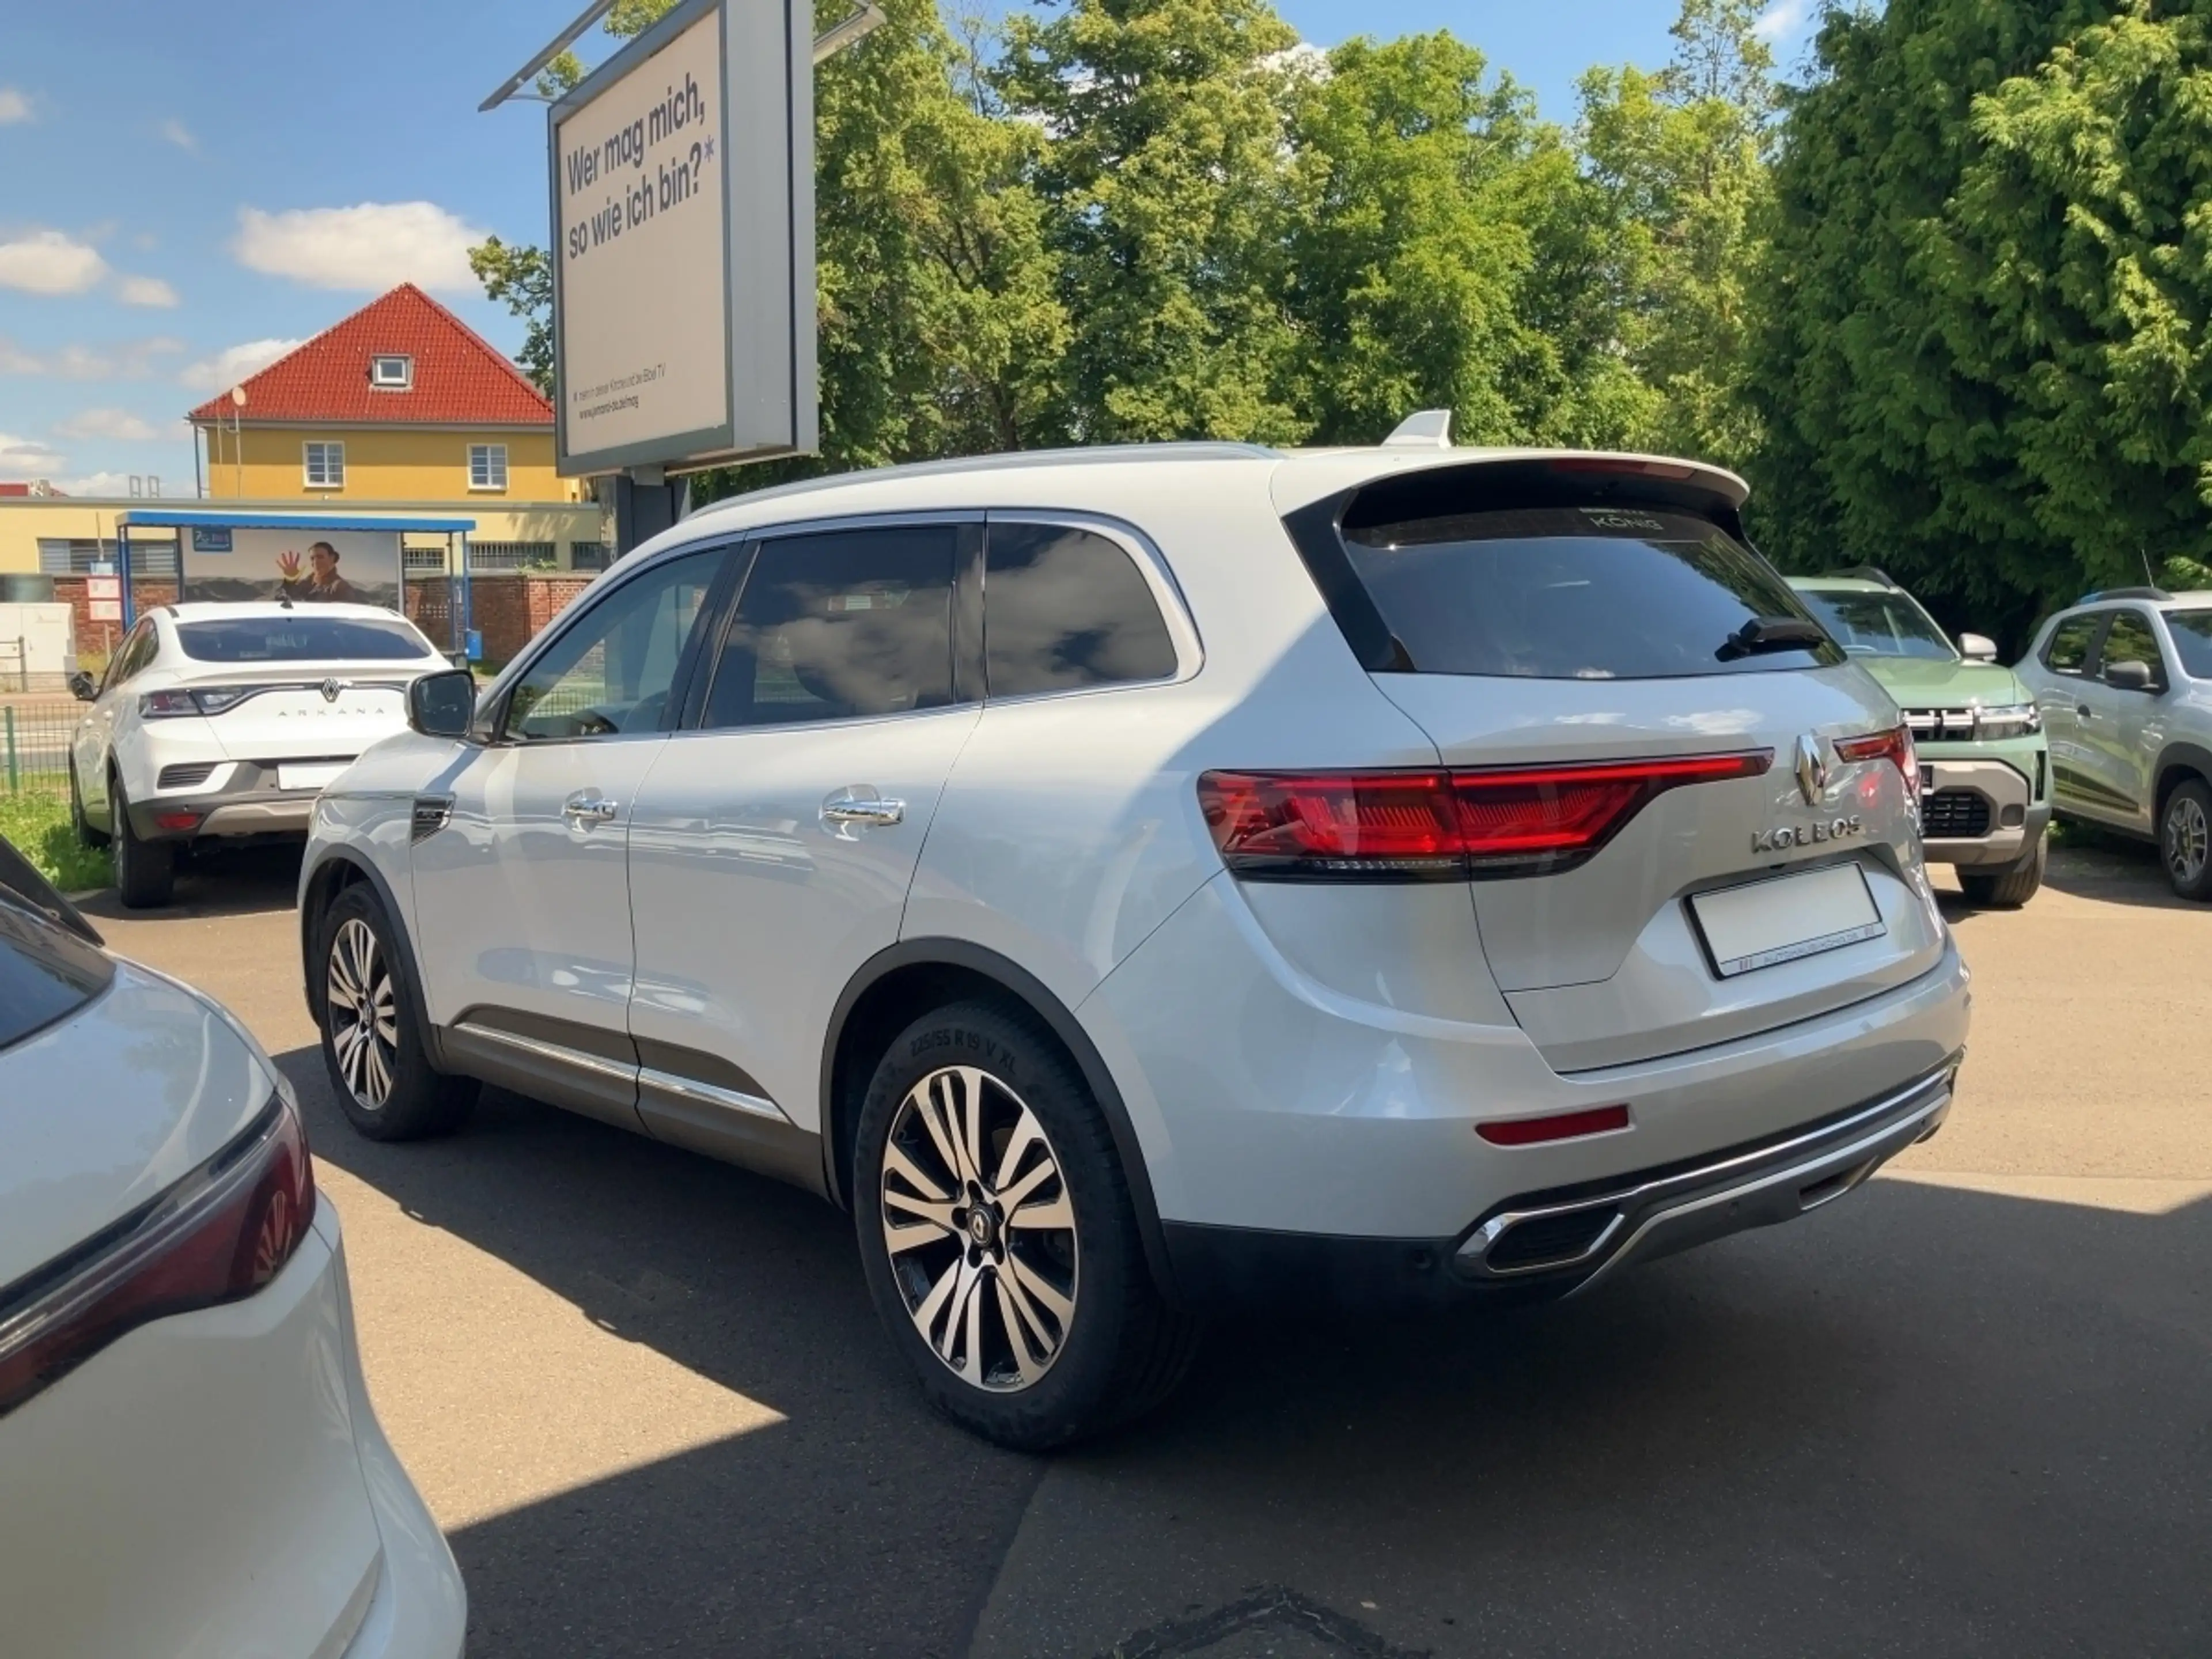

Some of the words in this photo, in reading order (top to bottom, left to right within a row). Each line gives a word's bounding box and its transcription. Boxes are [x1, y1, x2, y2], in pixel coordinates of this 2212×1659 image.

[567, 145, 600, 195] Wer
[604, 118, 644, 175] mag
[649, 71, 705, 147] mich,
[569, 221, 588, 260] so
[592, 196, 622, 247] wie
[627, 173, 654, 230] ich
[278, 707, 384, 717] ARKANA
[1751, 814, 1862, 854] KOLEOS
